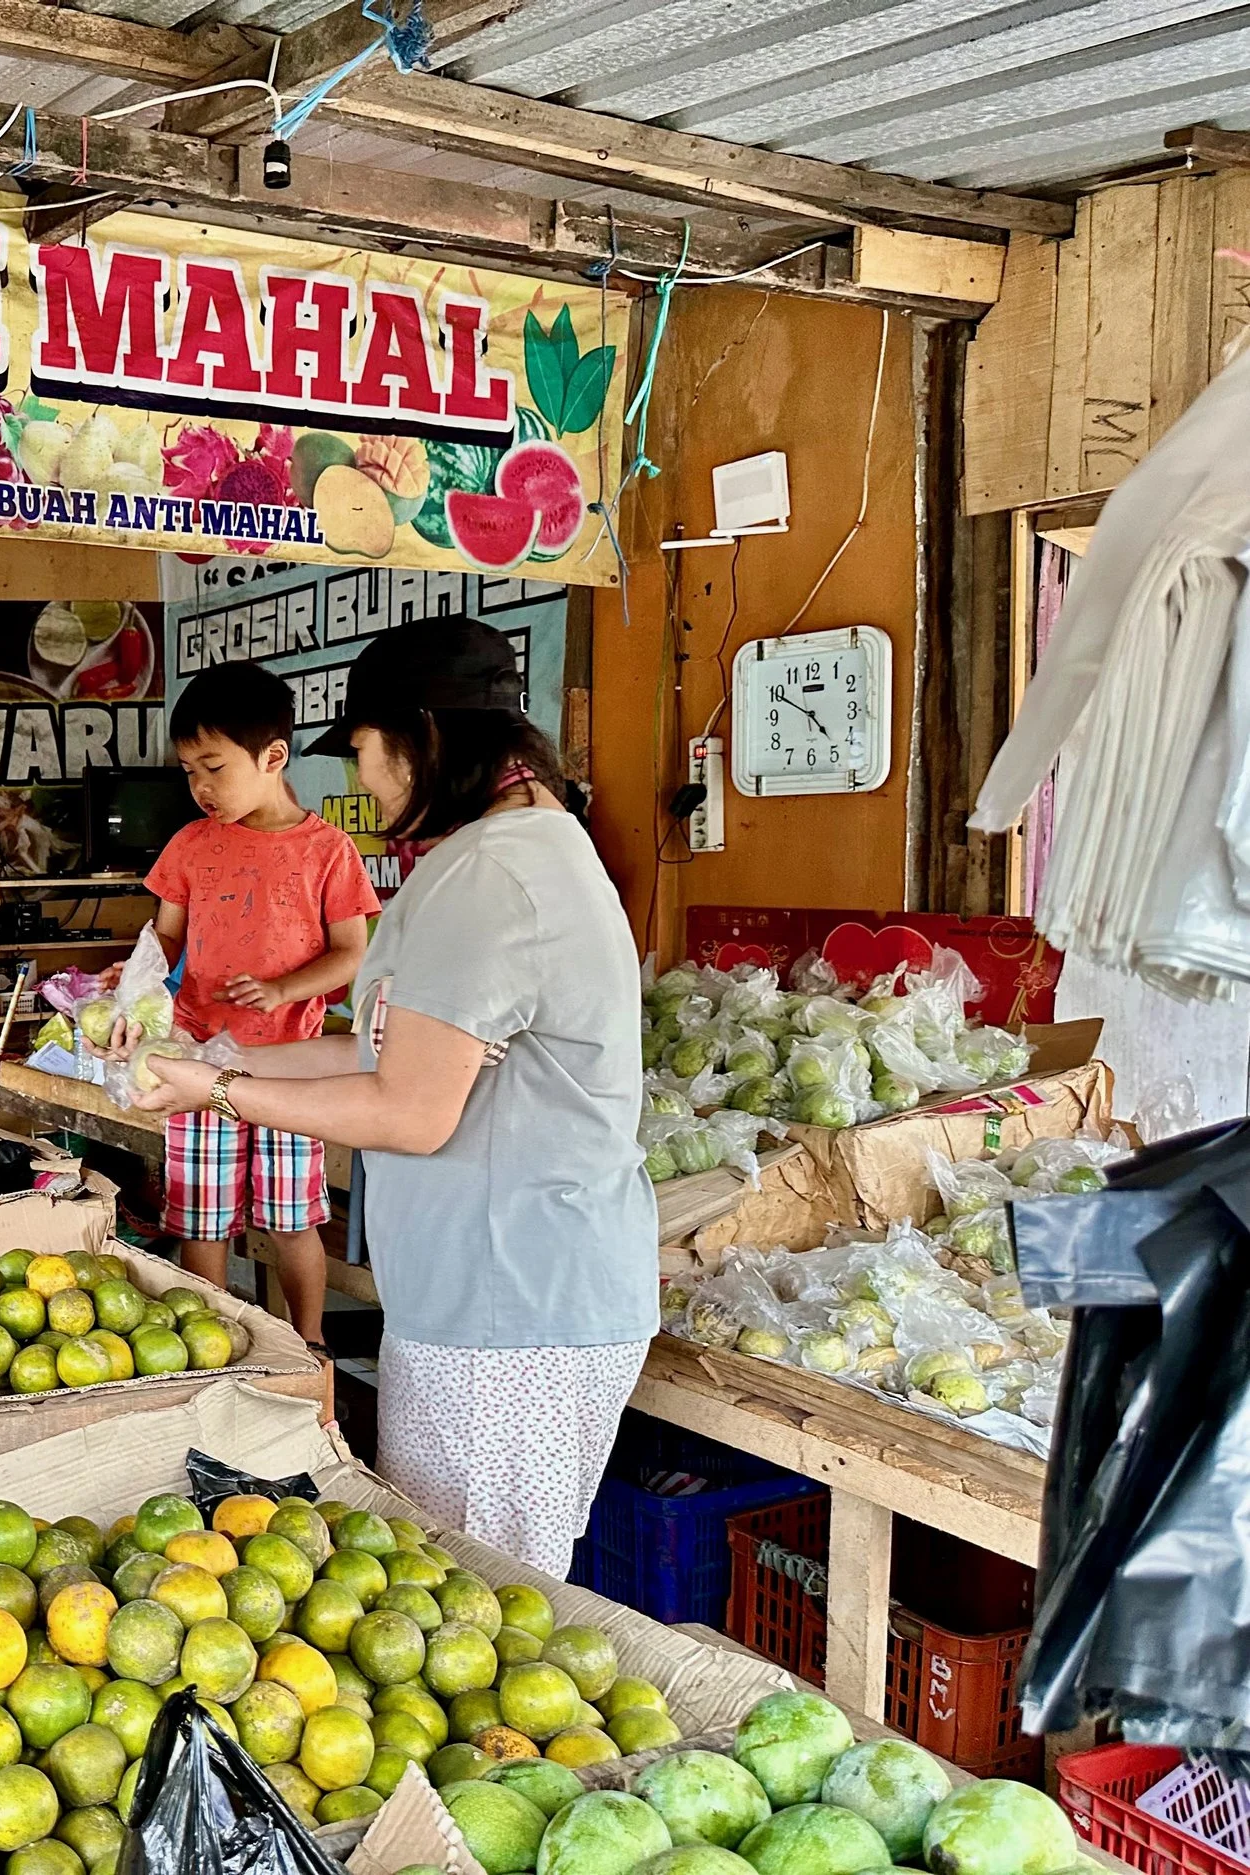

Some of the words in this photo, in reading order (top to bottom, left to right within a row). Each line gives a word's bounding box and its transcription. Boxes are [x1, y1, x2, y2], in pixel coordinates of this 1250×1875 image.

[30, 242, 516, 440] MAHAL
[105, 492, 194, 534] ANTI
[200, 500, 326, 545] MAHAL
[177, 582, 320, 677] GROSIR
[324, 567, 467, 648] BUAH
[786, 667, 798, 685] 11
[805, 662, 820, 681] 12
[833, 661, 838, 679] 1
[846, 674, 856, 693] 2
[770, 684, 784, 702] 10
[770, 709, 778, 726] 9
[847, 701, 857, 720] 3
[771, 732, 780, 750] 8
[844, 726, 855, 745] 4
[785, 748, 794, 765] 7
[807, 748, 816, 766] 6
[829, 745, 839, 763] 5
